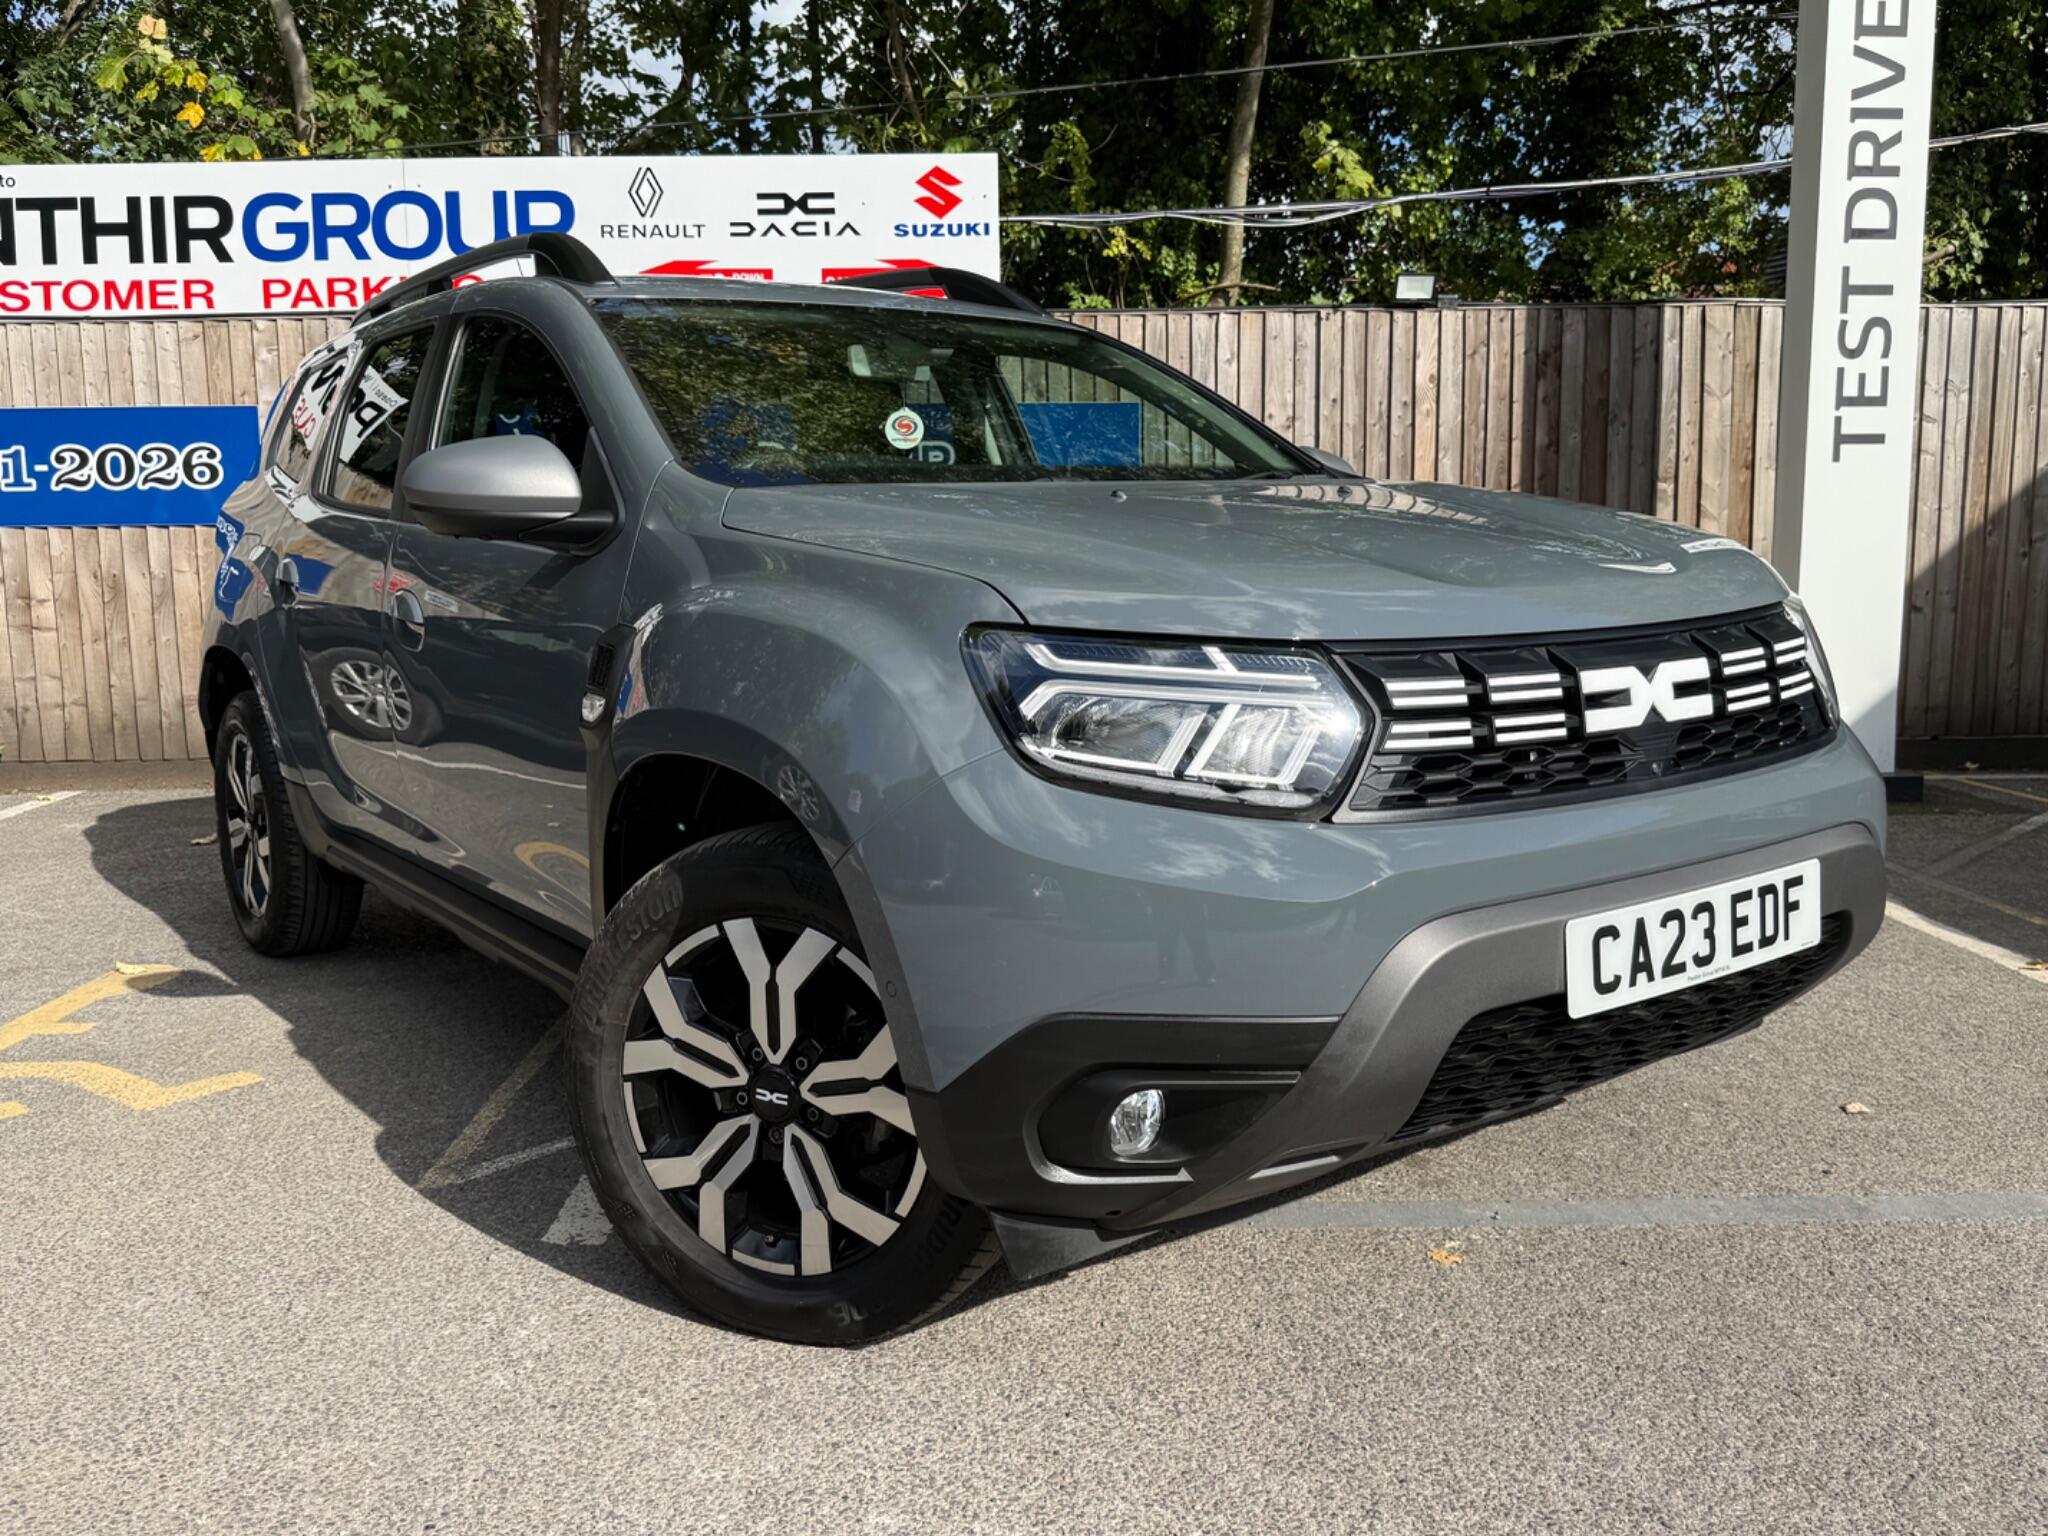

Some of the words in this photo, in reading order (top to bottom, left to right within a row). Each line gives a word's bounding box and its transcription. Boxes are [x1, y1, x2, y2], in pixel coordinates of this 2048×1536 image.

[1843, 0, 1910, 244] DRIVE
[600, 223, 707, 239] RENAULT
[729, 221, 862, 237] DACIA
[894, 222, 991, 238] SUZUKI
[1832, 265, 1894, 463] TEST
[1592, 900, 1717, 996] CA23
[1730, 874, 1804, 958] EDF
